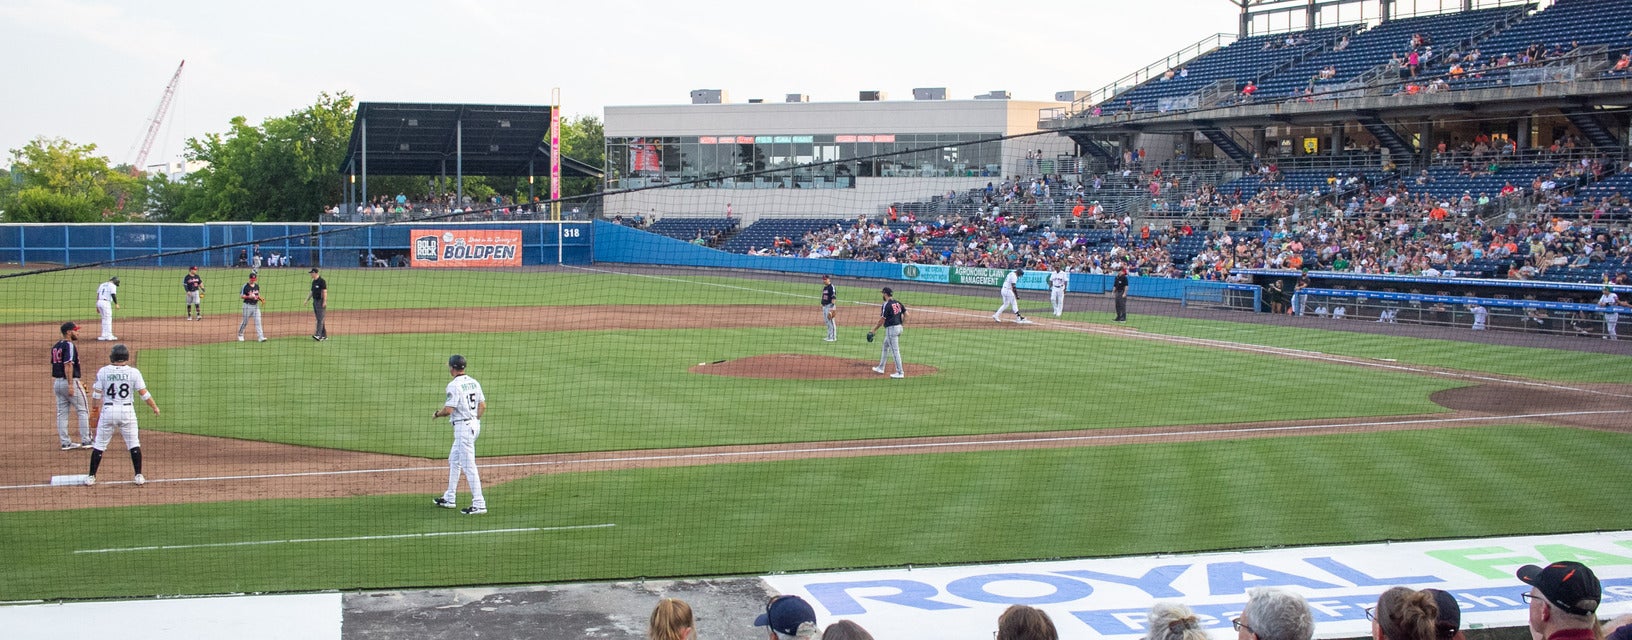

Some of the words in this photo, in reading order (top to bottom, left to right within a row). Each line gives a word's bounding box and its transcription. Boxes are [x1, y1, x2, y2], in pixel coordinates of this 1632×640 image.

[564, 228, 580, 238] 318
[417, 240, 436, 248] BOLD
[417, 247, 437, 256] ROCK
[443, 245, 515, 260] BOLDPEN
[955, 267, 988, 277] AGRONOMIC
[989, 268, 1005, 278] LAWN
[961, 275, 999, 286] MANAGEMENT
[106, 382, 130, 399] 48
[466, 393, 476, 410] 15
[803, 556, 1446, 616] ROYAL
[1424, 539, 1632, 579] FA
